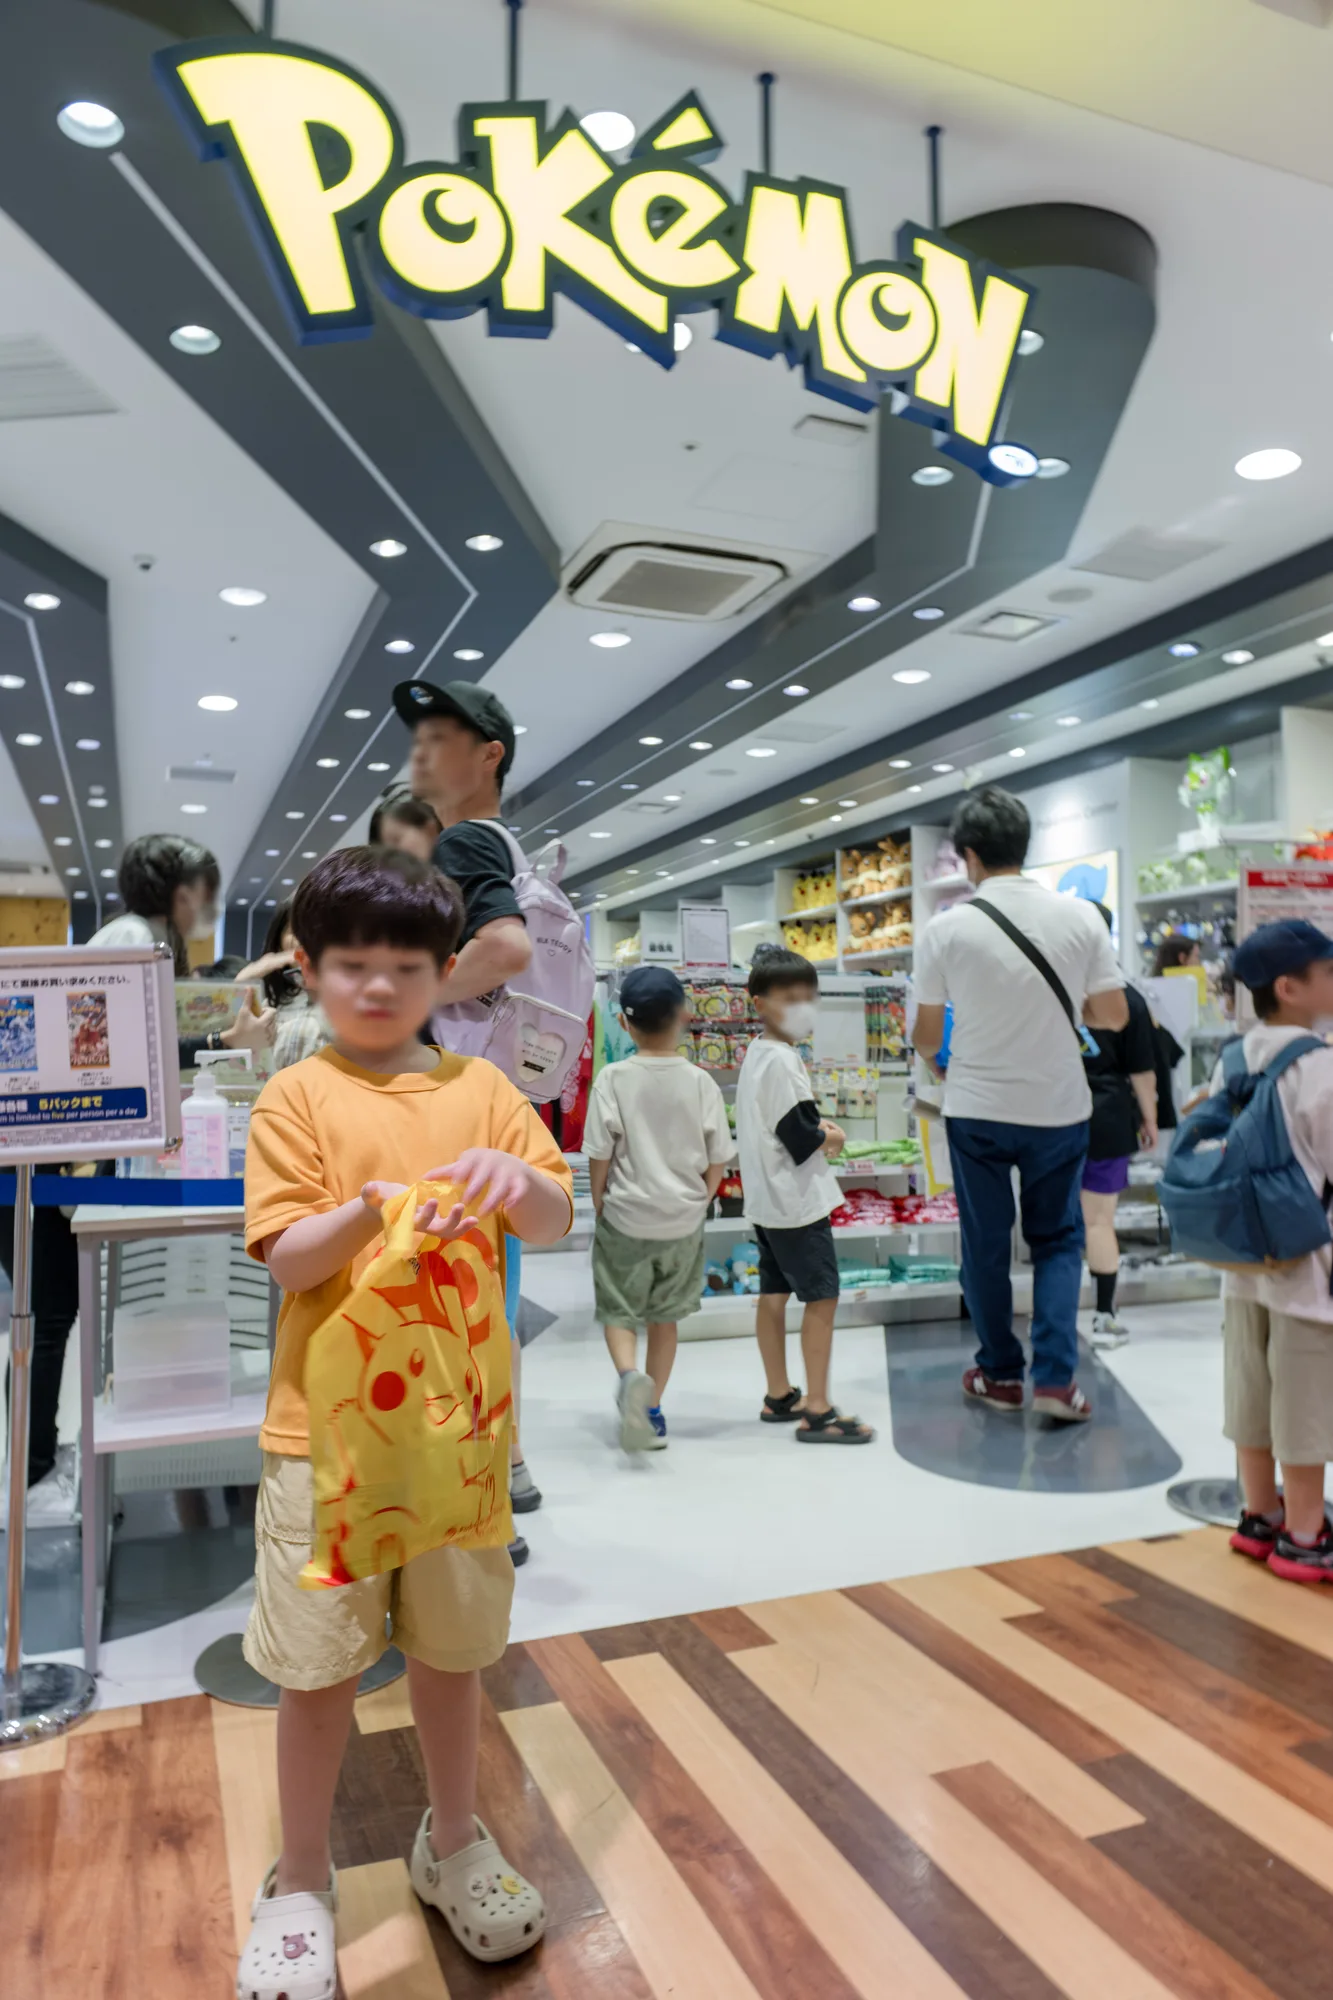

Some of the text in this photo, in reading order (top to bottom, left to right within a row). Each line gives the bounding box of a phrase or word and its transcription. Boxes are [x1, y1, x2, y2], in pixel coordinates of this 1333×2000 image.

[42, 1111, 50, 1120] to
[80, 1109, 104, 1120] person
[106, 1108, 118, 1118] per
[125, 1107, 138, 1117] day
